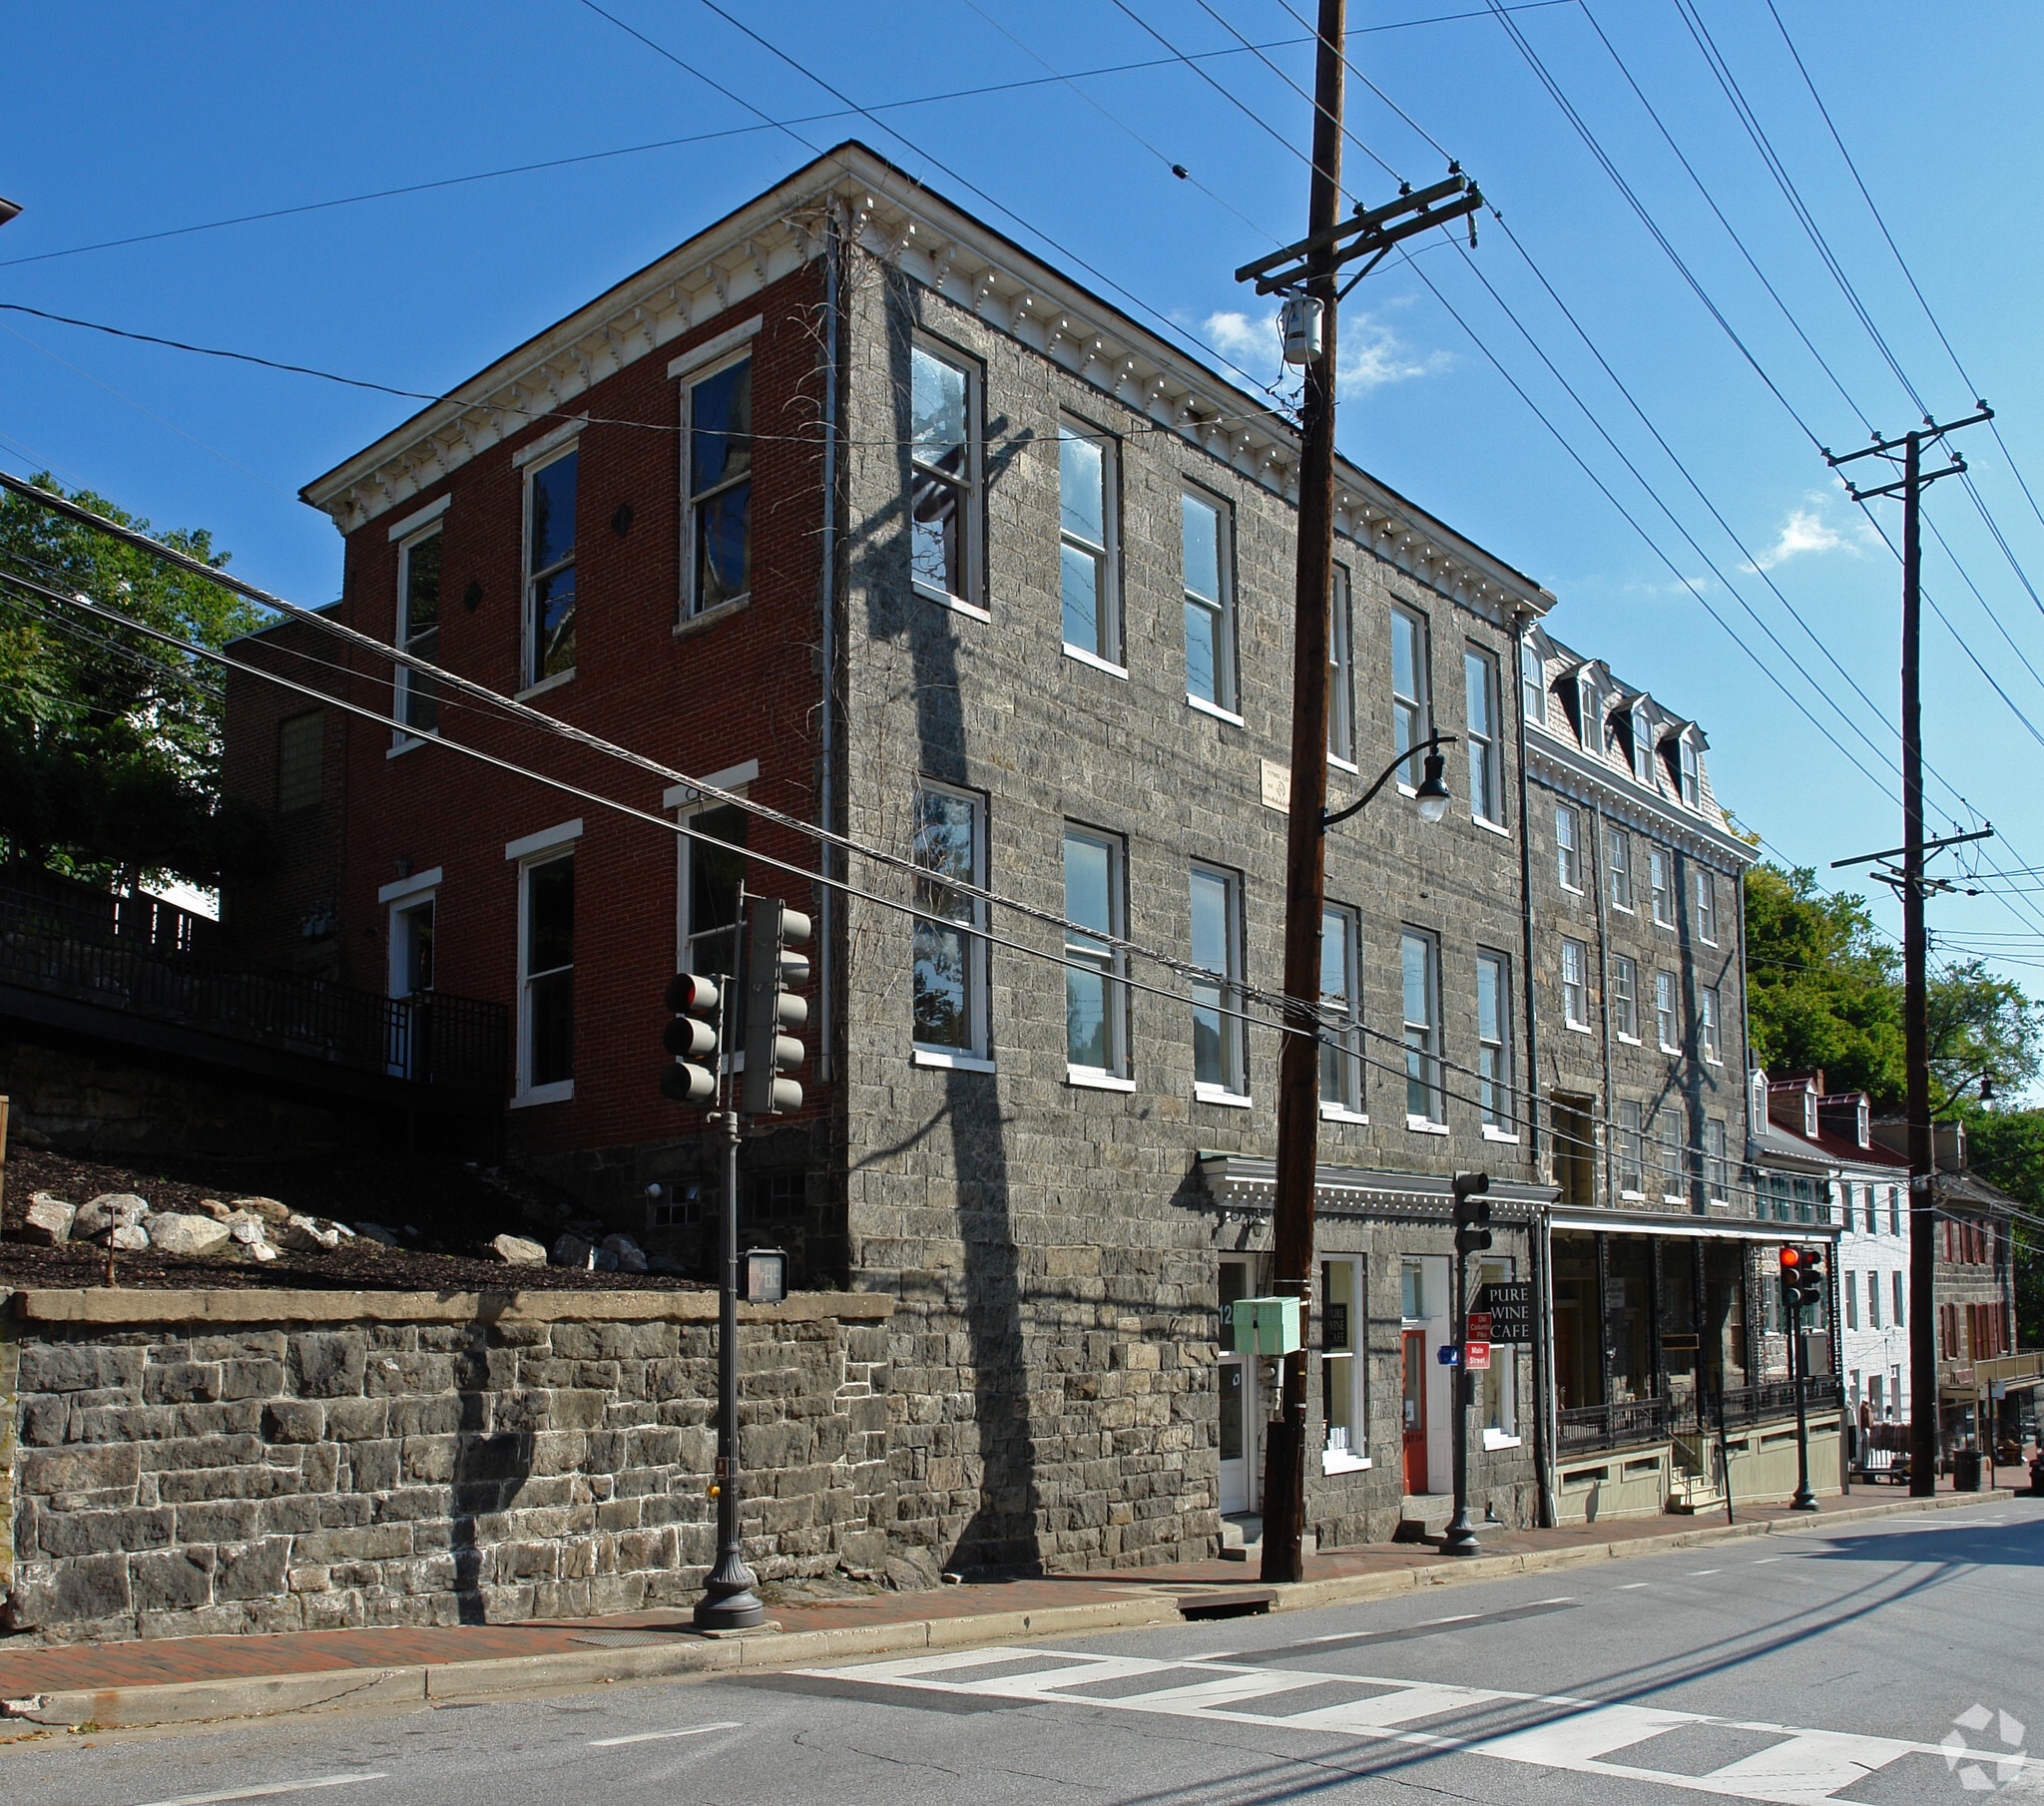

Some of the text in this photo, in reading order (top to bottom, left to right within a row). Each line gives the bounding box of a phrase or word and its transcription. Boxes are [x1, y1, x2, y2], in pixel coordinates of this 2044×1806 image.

[1489, 1287, 1529, 1302] PURE
[1490, 1306, 1529, 1319] WINE
[1490, 1324, 1529, 1338] CAFE
[1469, 1356, 1486, 1365] Street
